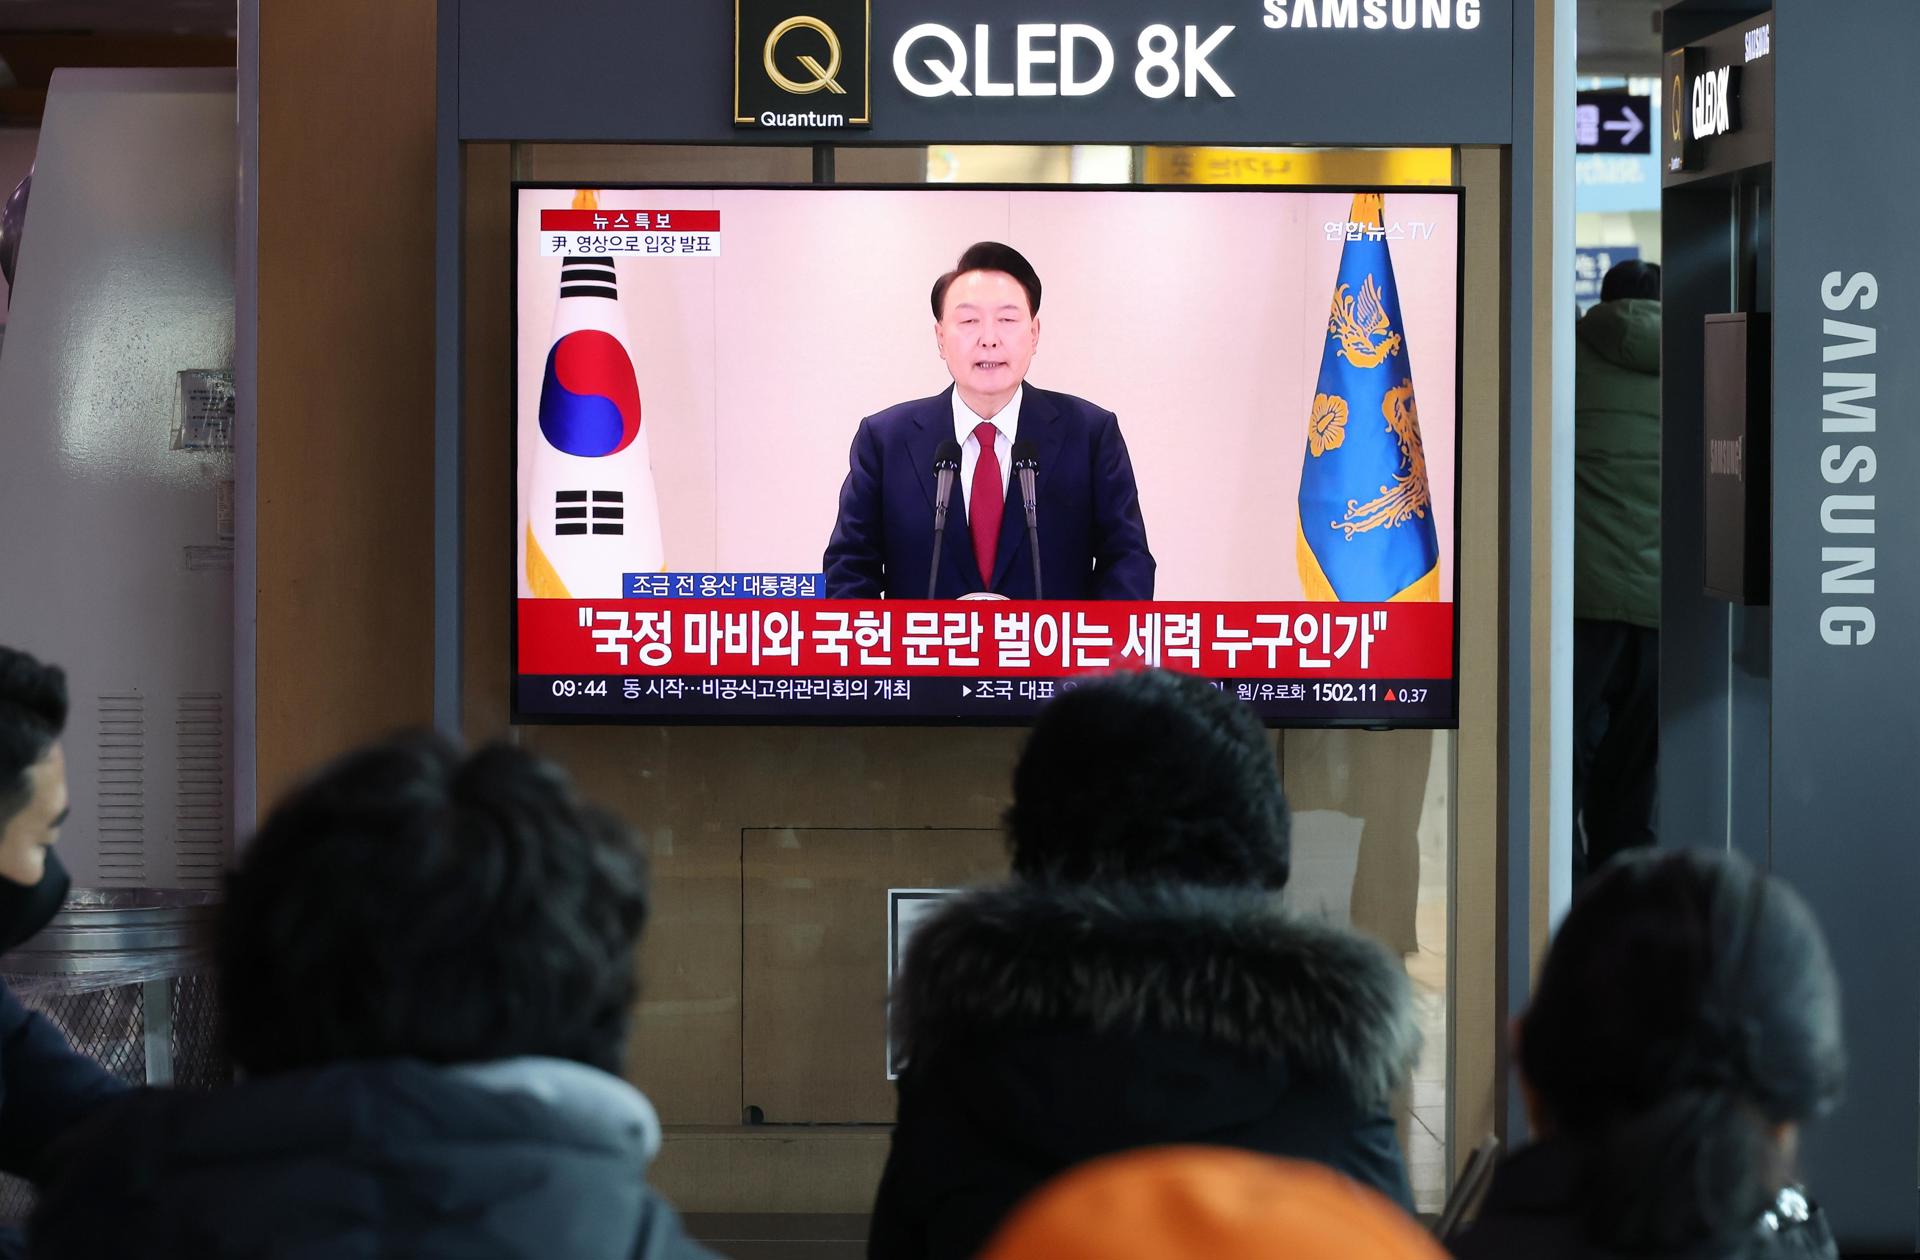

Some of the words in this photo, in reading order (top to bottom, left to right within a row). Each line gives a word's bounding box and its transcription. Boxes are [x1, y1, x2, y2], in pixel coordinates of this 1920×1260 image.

[1263, 0, 1481, 30] SAMSUNG
[892, 23, 1115, 99] QLED
[1135, 24, 1236, 99] 8K
[760, 111, 844, 127] Quantum
[576, 235, 640, 252] 영상으로
[644, 235, 676, 253] 입장
[680, 235, 712, 252] 발표
[1820, 270, 1879, 646] SAMSUNG
[632, 575, 671, 596] 조금
[675, 575, 695, 596] 전
[699, 575, 737, 596] 용산
[743, 575, 816, 596] 대통령실
[578, 607, 673, 667] "국정
[684, 610, 804, 667] 마비와
[812, 610, 893, 667] 국헌
[902, 610, 984, 668] 문란
[993, 610, 1113, 669] 벌이는
[1121, 610, 1201, 669] 세력
[1211, 610, 1388, 670] 누구인가"
[552, 680, 608, 697] 09:44
[623, 679, 641, 698] 동
[874, 679, 911, 699] 개최
[975, 680, 1014, 700] 조국
[1020, 680, 1055, 700] 대표
[1237, 683, 1306, 701] 원/유로화
[1312, 683, 1377, 702] 1502.11
[1398, 689, 1428, 703] 0.37
